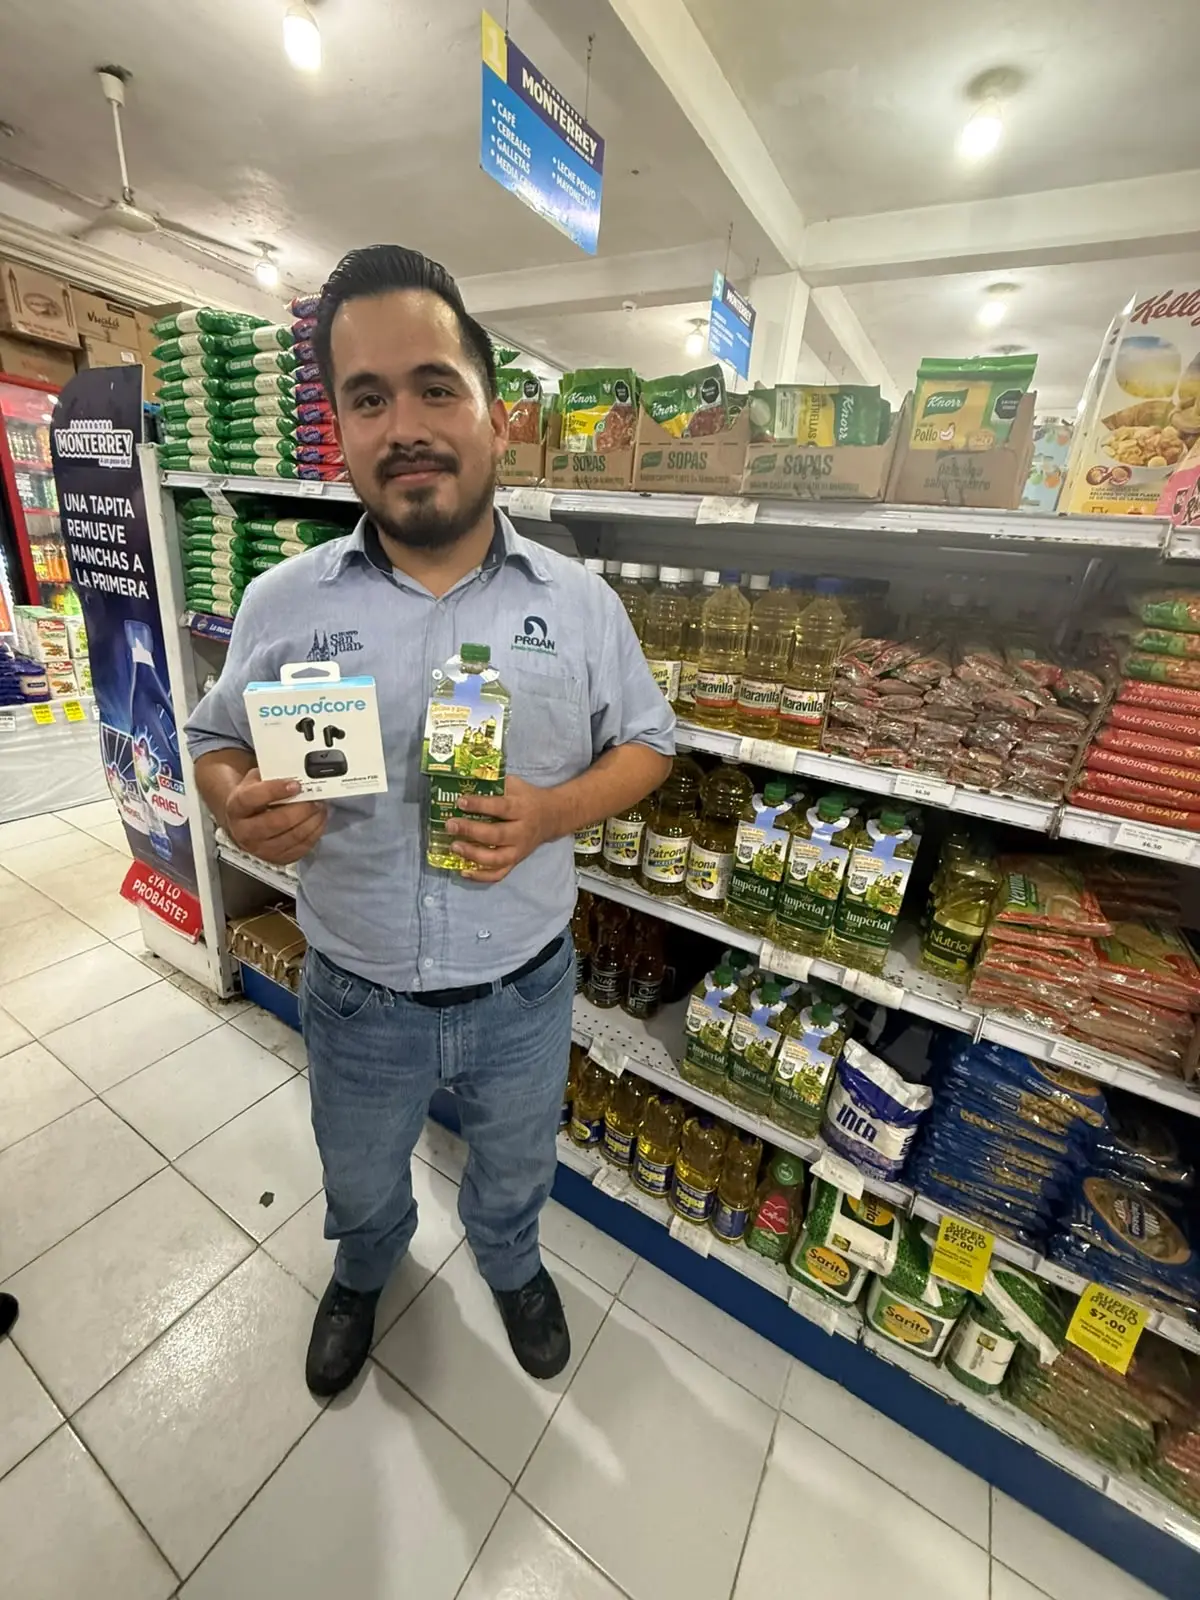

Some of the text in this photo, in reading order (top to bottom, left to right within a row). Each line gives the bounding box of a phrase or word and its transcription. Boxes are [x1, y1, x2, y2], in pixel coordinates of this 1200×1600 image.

[488, 27, 502, 69] 1
[497, 102, 516, 128] CAFÉ
[522, 67, 598, 157] MONTERREY
[497, 120, 532, 159] CEREALES
[496, 137, 531, 175] GALLETAS
[496, 154, 521, 182] MEDIA
[557, 158, 596, 200] LECHE POLVO
[1130, 289, 1200, 327] Kello
[567, 392, 598, 404] Knorr
[652, 401, 679, 417] Knorr
[927, 395, 961, 408] Knorr
[838, 394, 855, 441] Knorr
[57, 432, 131, 455] MONTERREY
[914, 428, 938, 441] Pollo
[573, 454, 606, 472] SOPAS
[667, 451, 708, 470] SOPAS
[782, 453, 834, 477] SOPAS
[63, 492, 136, 519] UNA TAPITA
[66, 518, 127, 545] REMUEVE
[71, 543, 145, 574] MANCHAS A
[75, 567, 92, 588] LA
[330, 633, 353, 646] San
[331, 641, 362, 657] Juan
[740, 686, 780, 704] Maravilla
[782, 695, 823, 713] Maravilla
[259, 698, 366, 718] soundcore
[1143, 718, 1196, 735] PRODUCTO
[1131, 742, 1183, 757] PRODUCTO
[1108, 755, 1159, 773] PRODUCTO
[159, 776, 185, 794] COLOR
[151, 793, 185, 818] ARIEL
[1096, 795, 1145, 812] PRODUCTO
[1146, 806, 1188, 820] GRATIS
[648, 844, 687, 859] Patrona
[148, 874, 182, 900] ¿YA LO
[732, 874, 770, 898] Imperial
[132, 878, 189, 924] PROBASTE?
[784, 893, 825, 917] Imperial
[846, 909, 891, 932] Imperial
[930, 929, 973, 953] Nutriol
[692, 1044, 726, 1064] Imperial
[733, 1061, 768, 1084] Imperial
[836, 1103, 878, 1143] INCA
[943, 1233, 974, 1252] $7.00
[945, 1226, 987, 1249] PRECIO
[950, 1221, 986, 1241] SUPER
[808, 1247, 849, 1280] Sarita
[1090, 1295, 1138, 1326] PRECIO
[1097, 1291, 1139, 1318] SUPER
[884, 1304, 931, 1336] Sarita
[1089, 1307, 1127, 1334] $7.00
